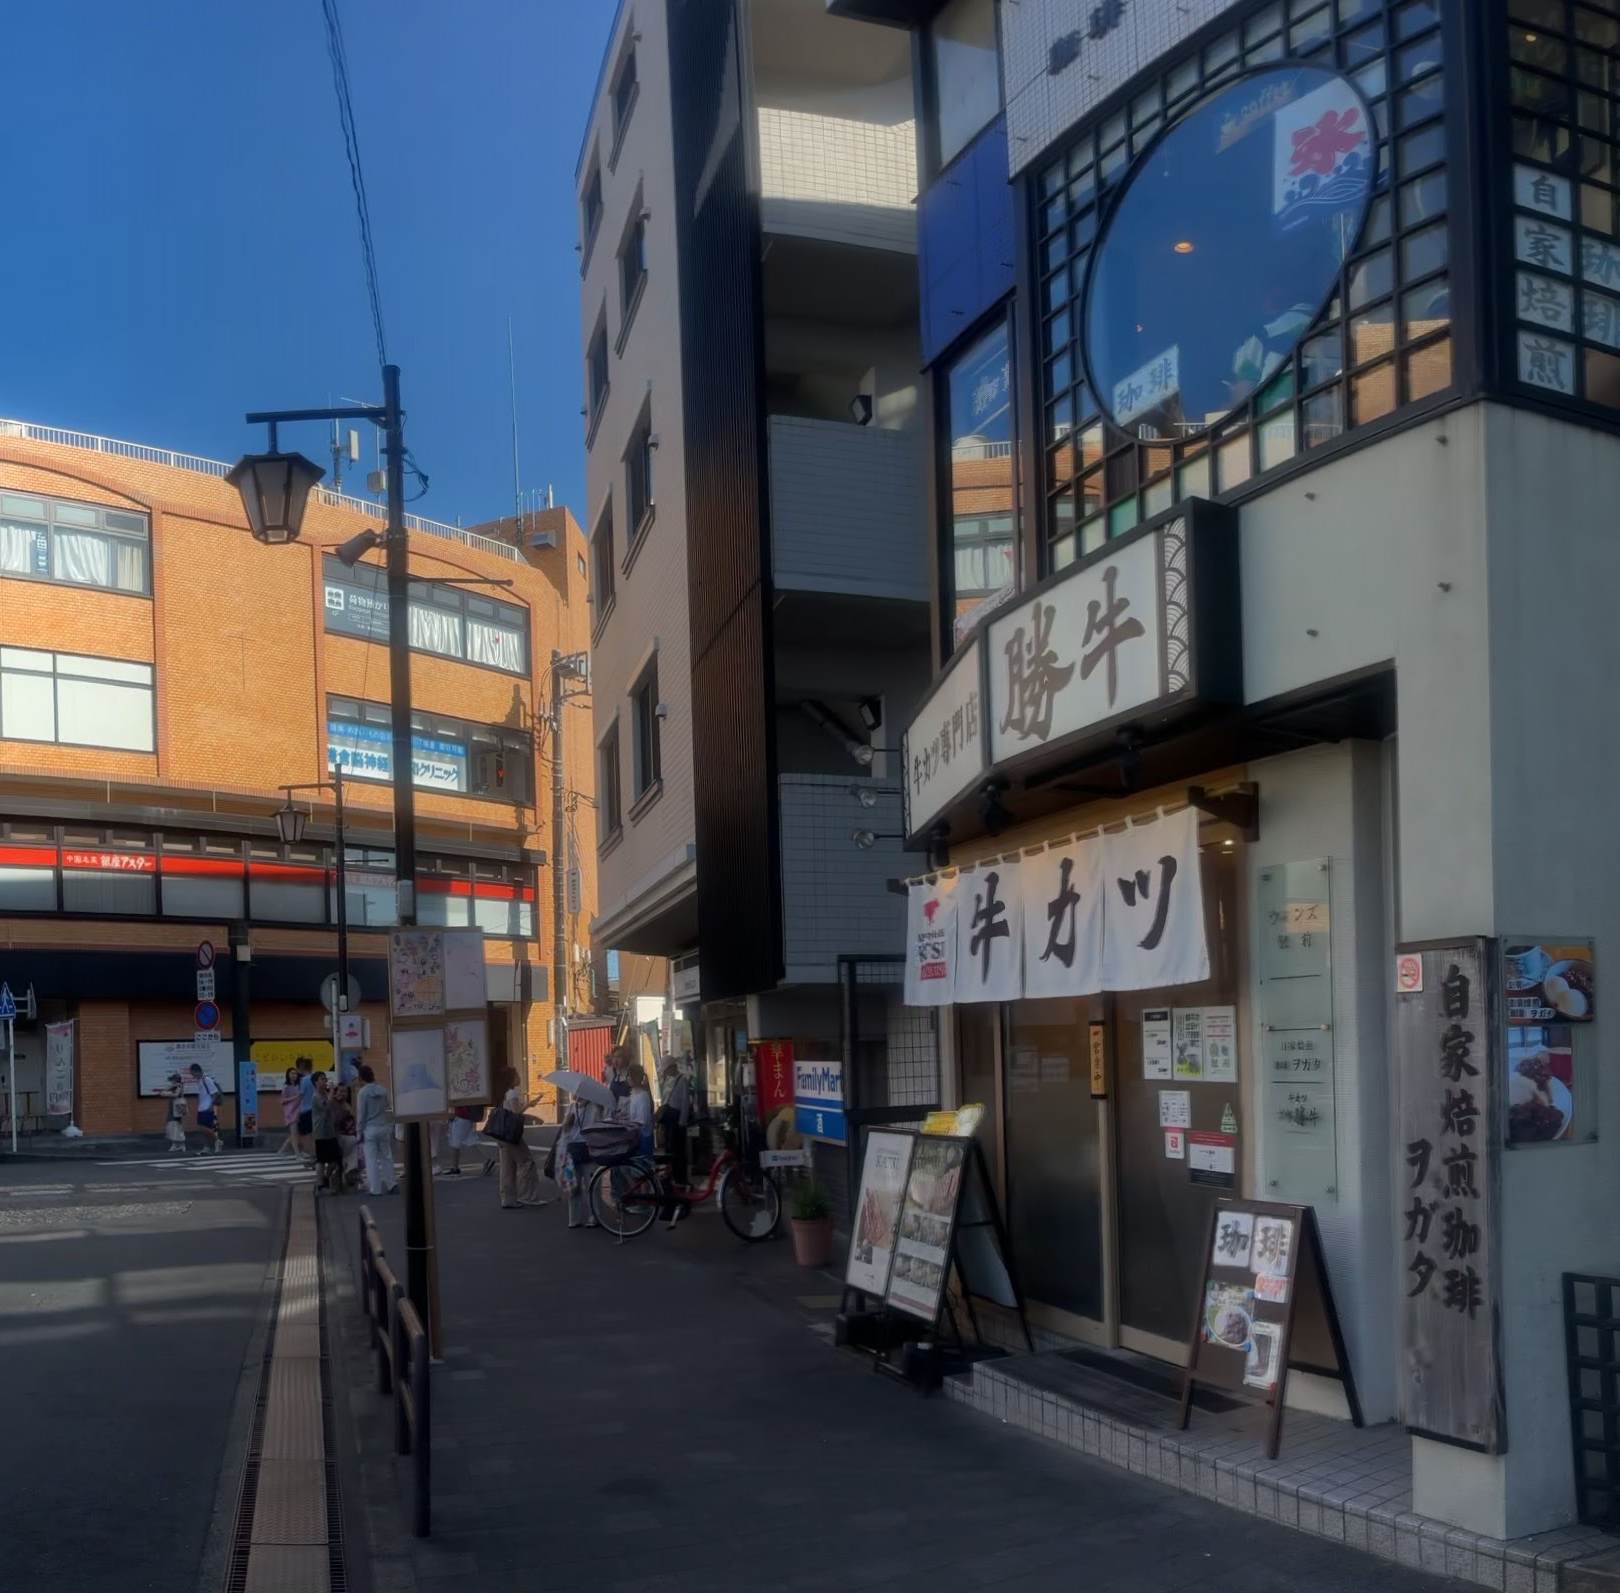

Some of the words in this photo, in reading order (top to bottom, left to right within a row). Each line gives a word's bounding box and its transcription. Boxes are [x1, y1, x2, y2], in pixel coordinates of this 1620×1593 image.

[1522, 175, 1567, 390] 自家焙煎
[999, 565, 1146, 742] 勝牛
[913, 691, 978, 796] 牛カツ専門店
[970, 855, 1177, 985] 牛カツ
[1403, 1138, 1437, 1300] ヲガタ
[1440, 964, 1483, 1321] 自家焙煎珈琲
[1218, 1220, 1286, 1269] 珈琲
